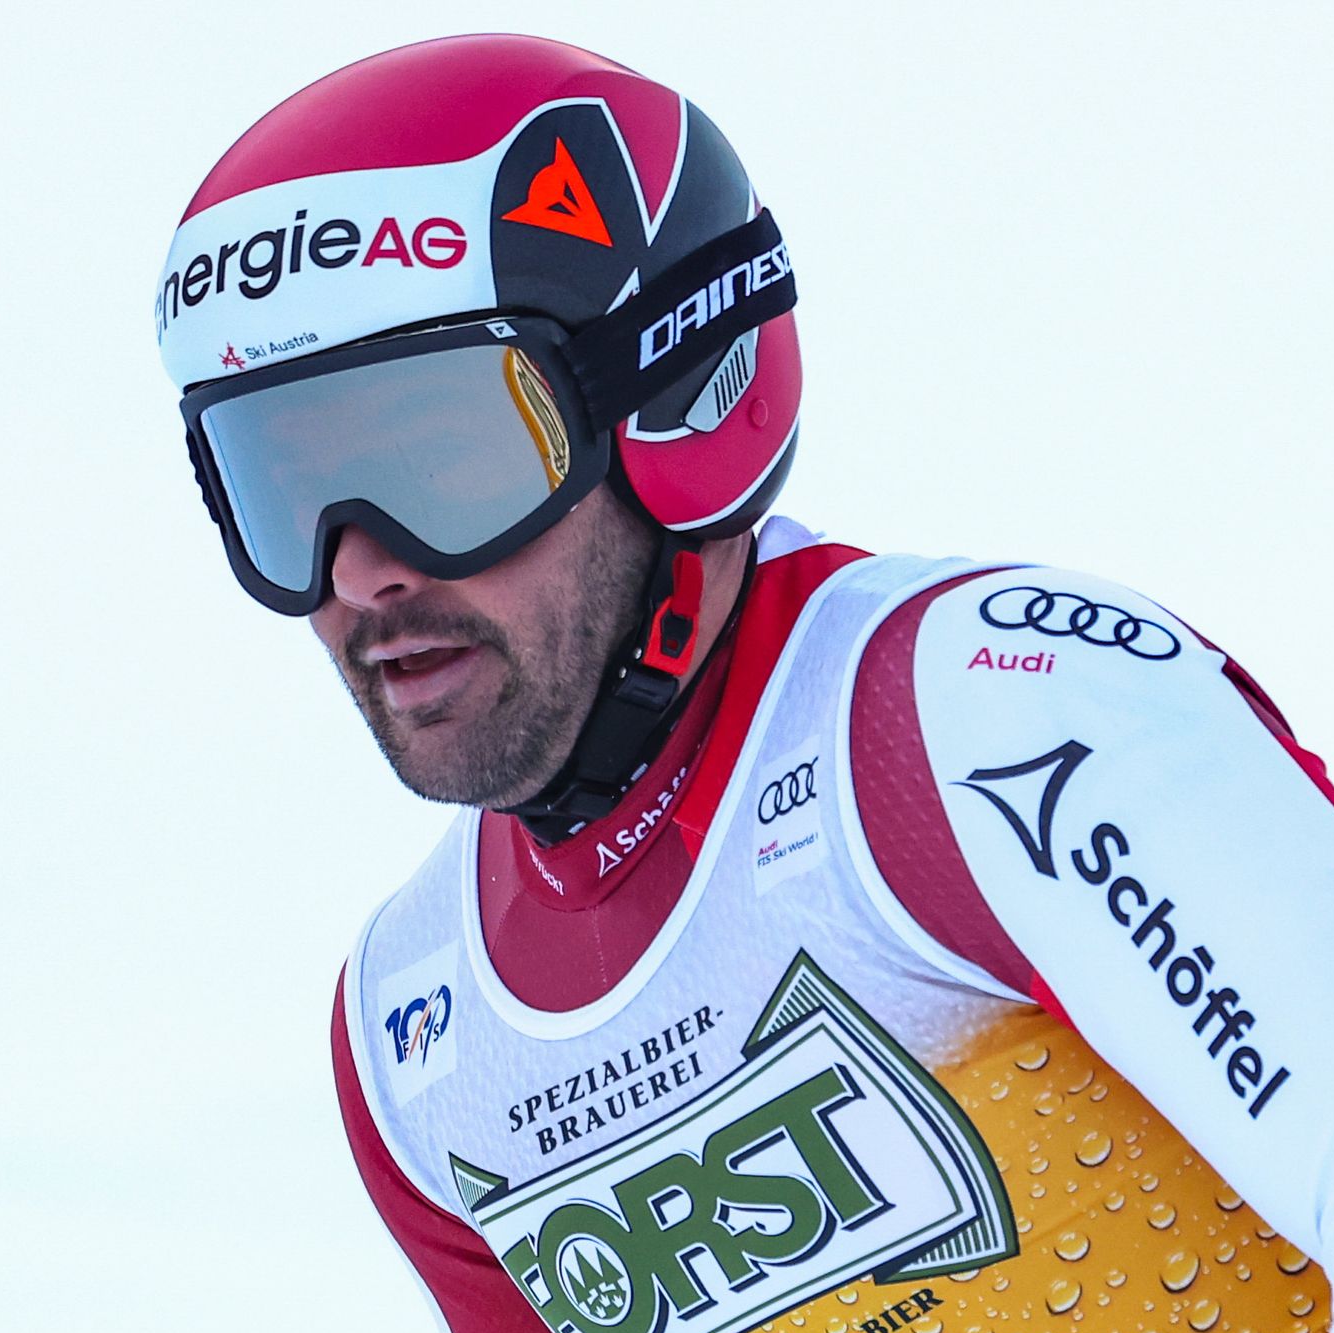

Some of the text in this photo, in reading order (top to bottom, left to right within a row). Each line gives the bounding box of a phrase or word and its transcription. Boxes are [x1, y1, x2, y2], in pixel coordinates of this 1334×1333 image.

[245, 331, 319, 361] Ski Austria
[967, 646, 1055, 675] Audi
[757, 832, 815, 868] FIS Ski World
[758, 840, 778, 857] Audi
[508, 1005, 724, 1133] SPEZIALBIER-
[535, 1051, 703, 1156] BRAUEREI
